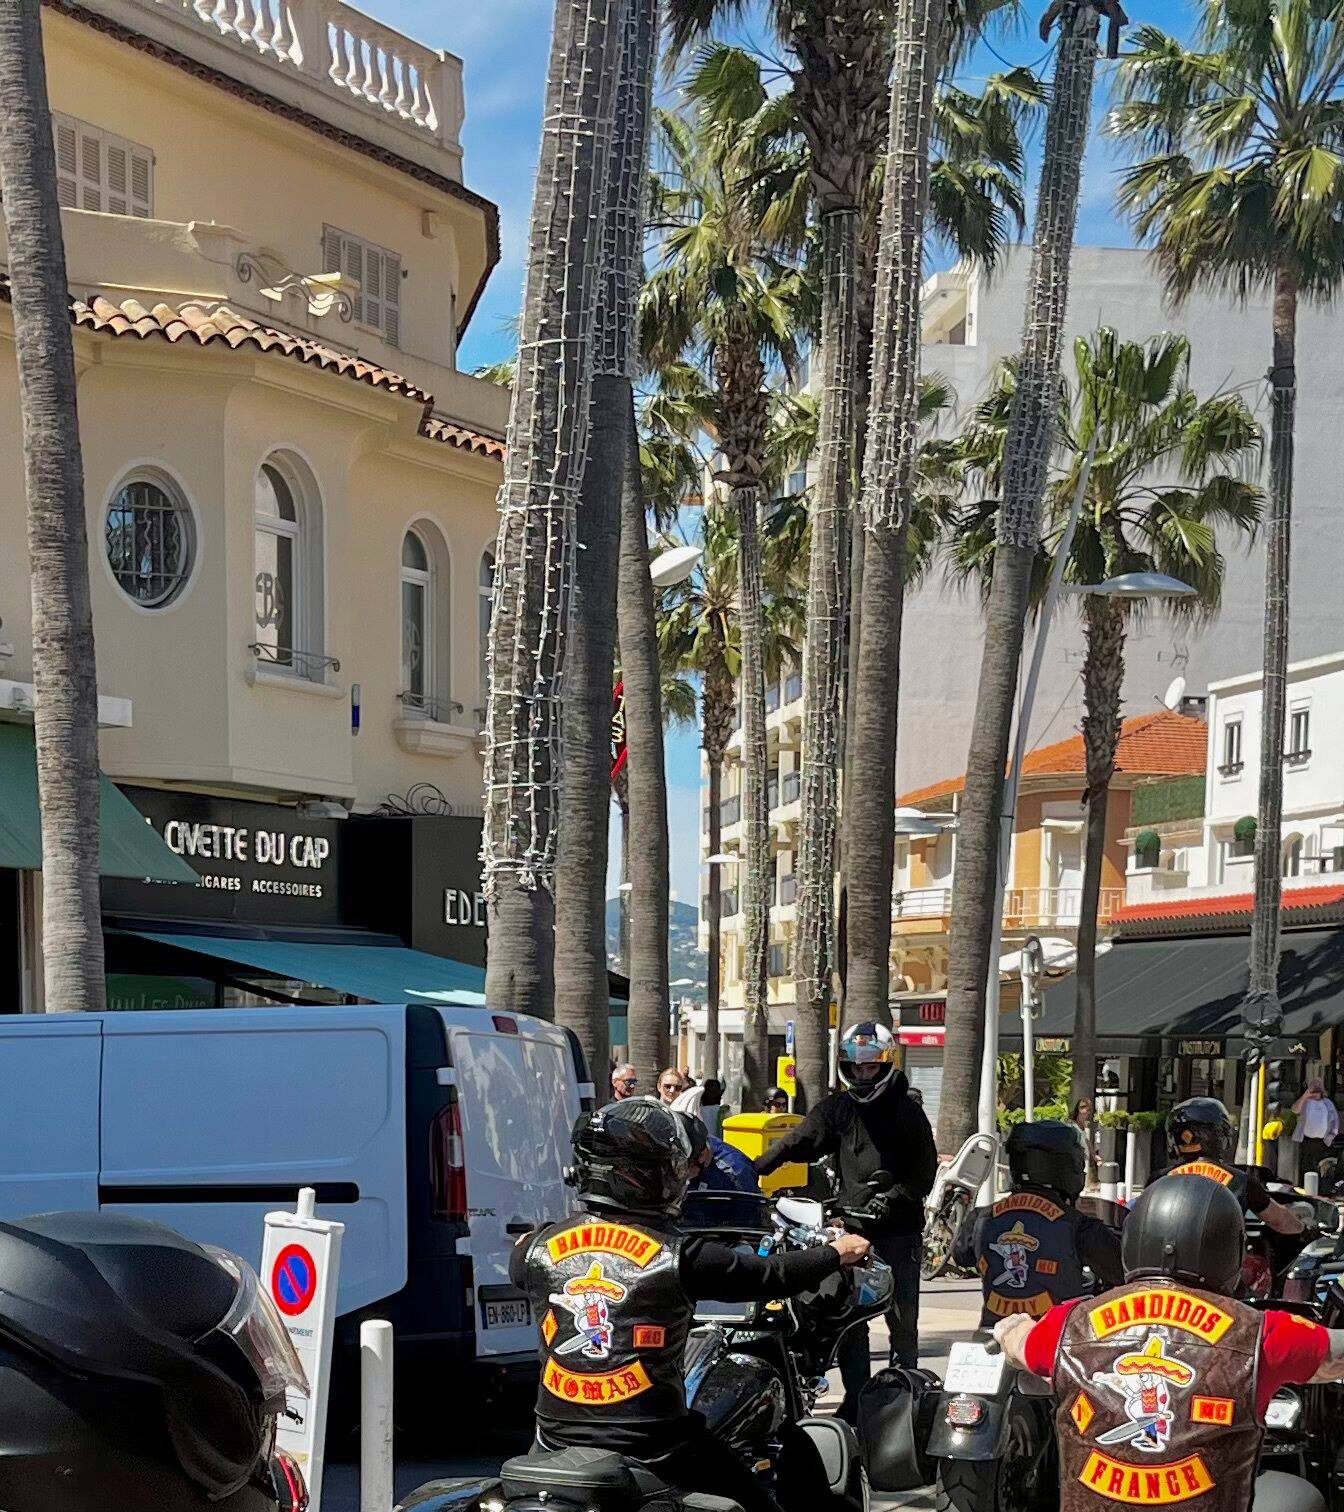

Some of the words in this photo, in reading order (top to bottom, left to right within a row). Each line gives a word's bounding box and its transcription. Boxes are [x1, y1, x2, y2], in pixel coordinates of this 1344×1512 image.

[164, 820, 248, 861] CIVETTE
[256, 830, 285, 865] DU
[289, 834, 330, 869] CAP
[195, 874, 241, 891] IGARES
[252, 879, 323, 898] ACCESSOIRES
[445, 888, 486, 927] EDE
[995, 1194, 1060, 1219] BANDIDOS
[556, 1226, 651, 1259] BANDIDOS
[995, 1298, 1038, 1314] ITALY
[1099, 1293, 1222, 1333] BANDIDOS
[548, 1368, 642, 1401] NOMAD
[1198, 1401, 1227, 1421] MC
[1089, 1459, 1202, 1499] FRANCE
